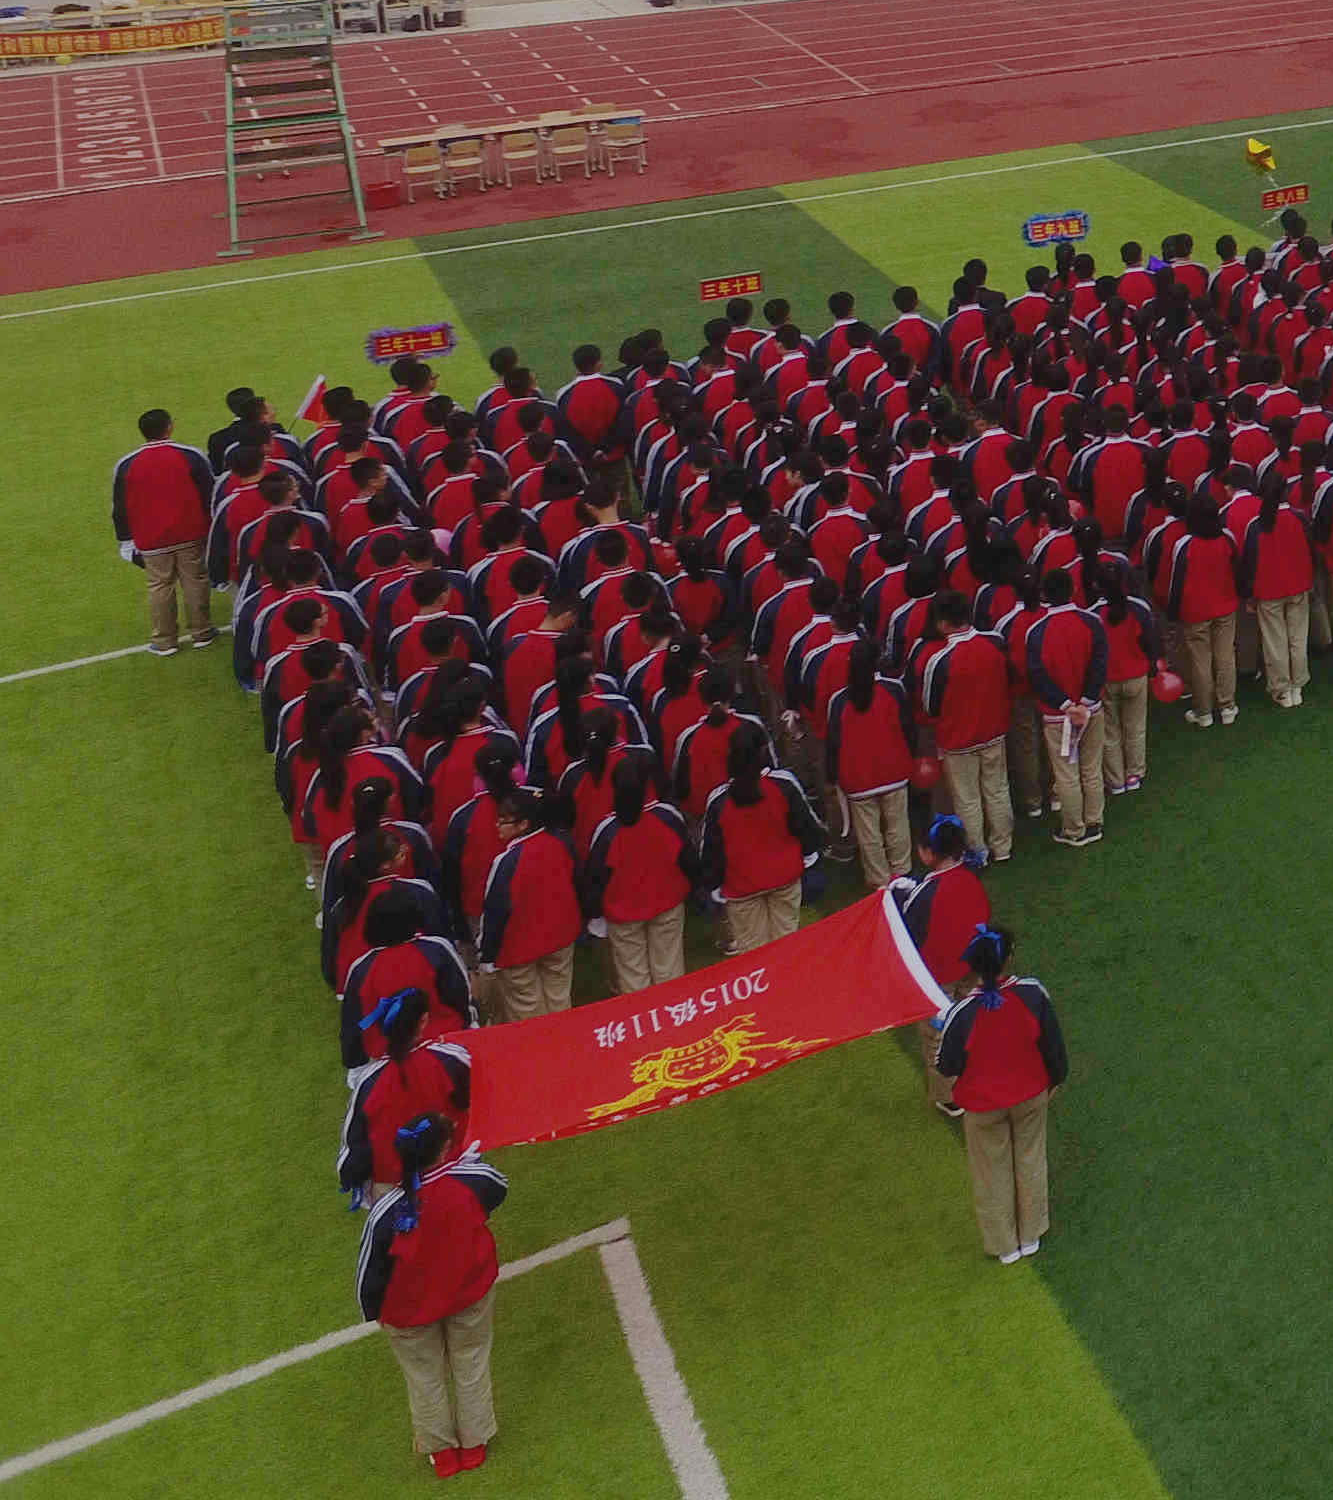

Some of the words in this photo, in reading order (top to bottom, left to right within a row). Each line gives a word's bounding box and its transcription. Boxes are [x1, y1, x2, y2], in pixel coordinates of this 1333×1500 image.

[1033, 219, 1081, 238] 三年九班
[704, 275, 760, 298] 三年十班
[379, 331, 444, 354] 三年十一班
[593, 967, 769, 1048] 2015级11班
